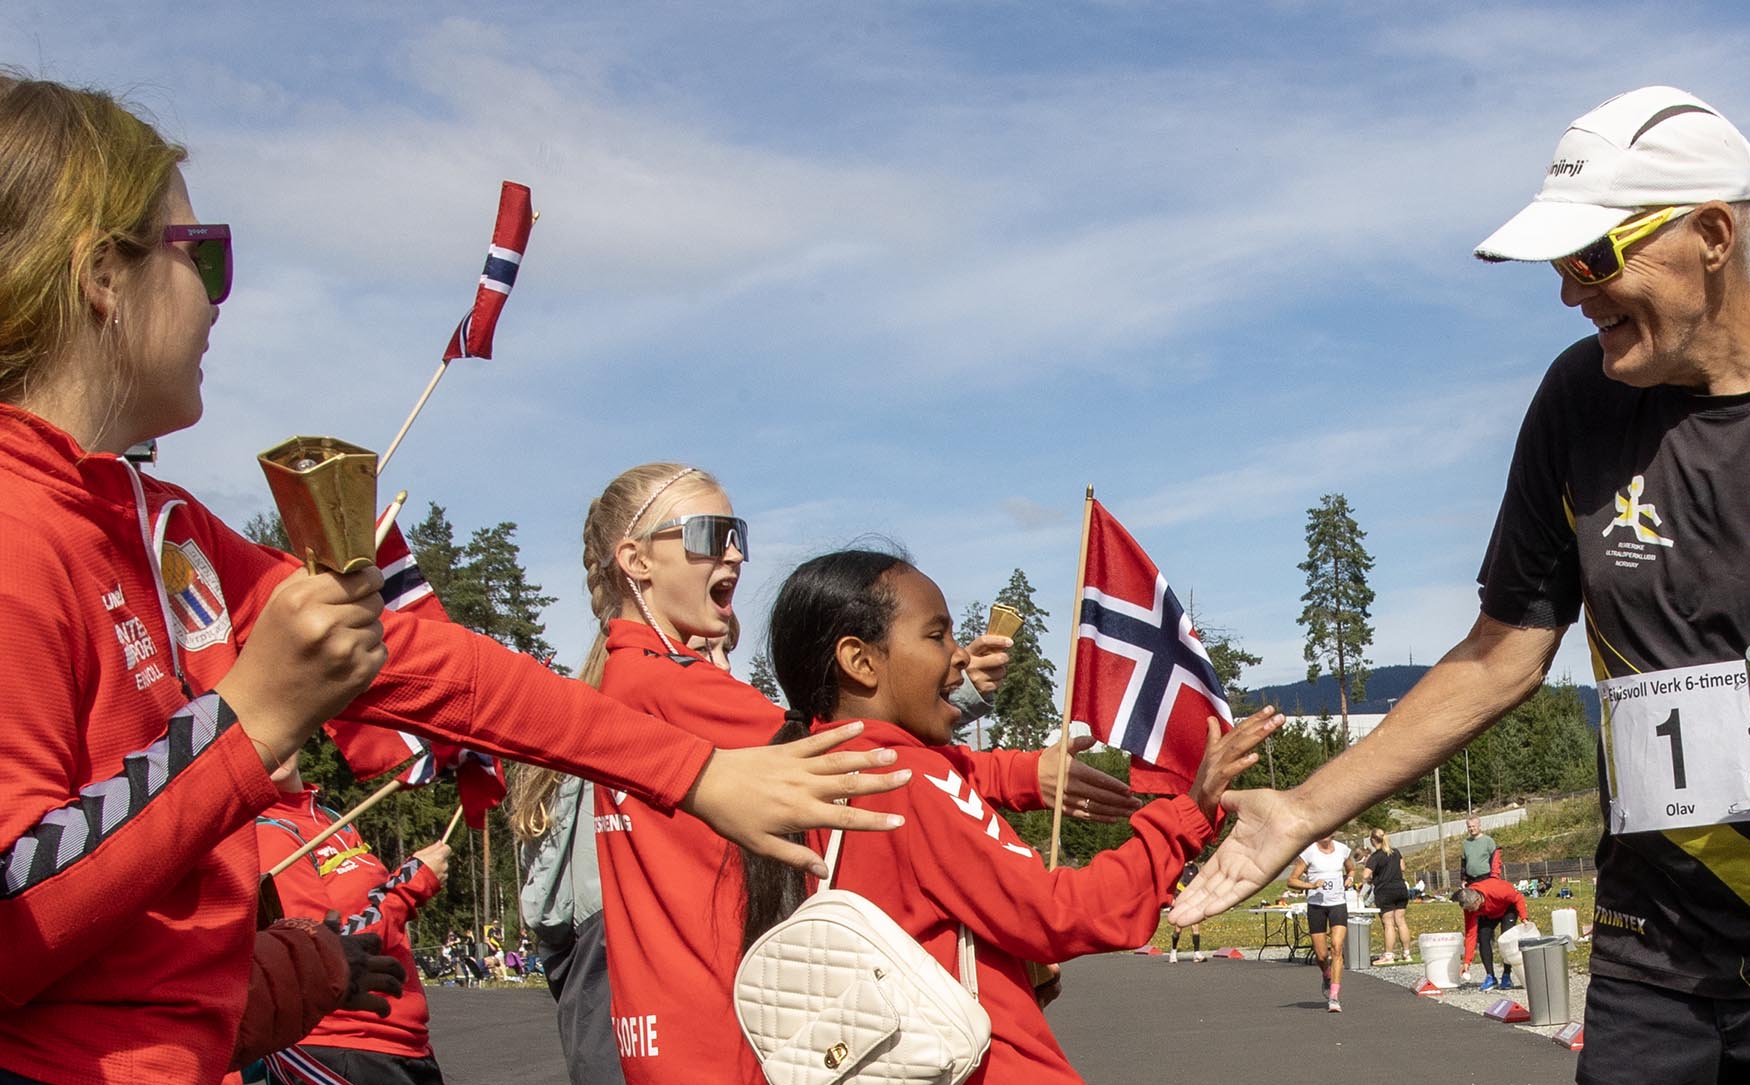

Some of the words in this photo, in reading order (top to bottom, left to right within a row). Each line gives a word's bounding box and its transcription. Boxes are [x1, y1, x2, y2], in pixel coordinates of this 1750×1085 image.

[1650, 677, 1682, 695] Verk
[1686, 671, 1746, 691] 6-timers
[1655, 708, 1687, 790] 1
[1665, 802, 1695, 817] Olav
[1595, 905, 1646, 935] TRIMTEX
